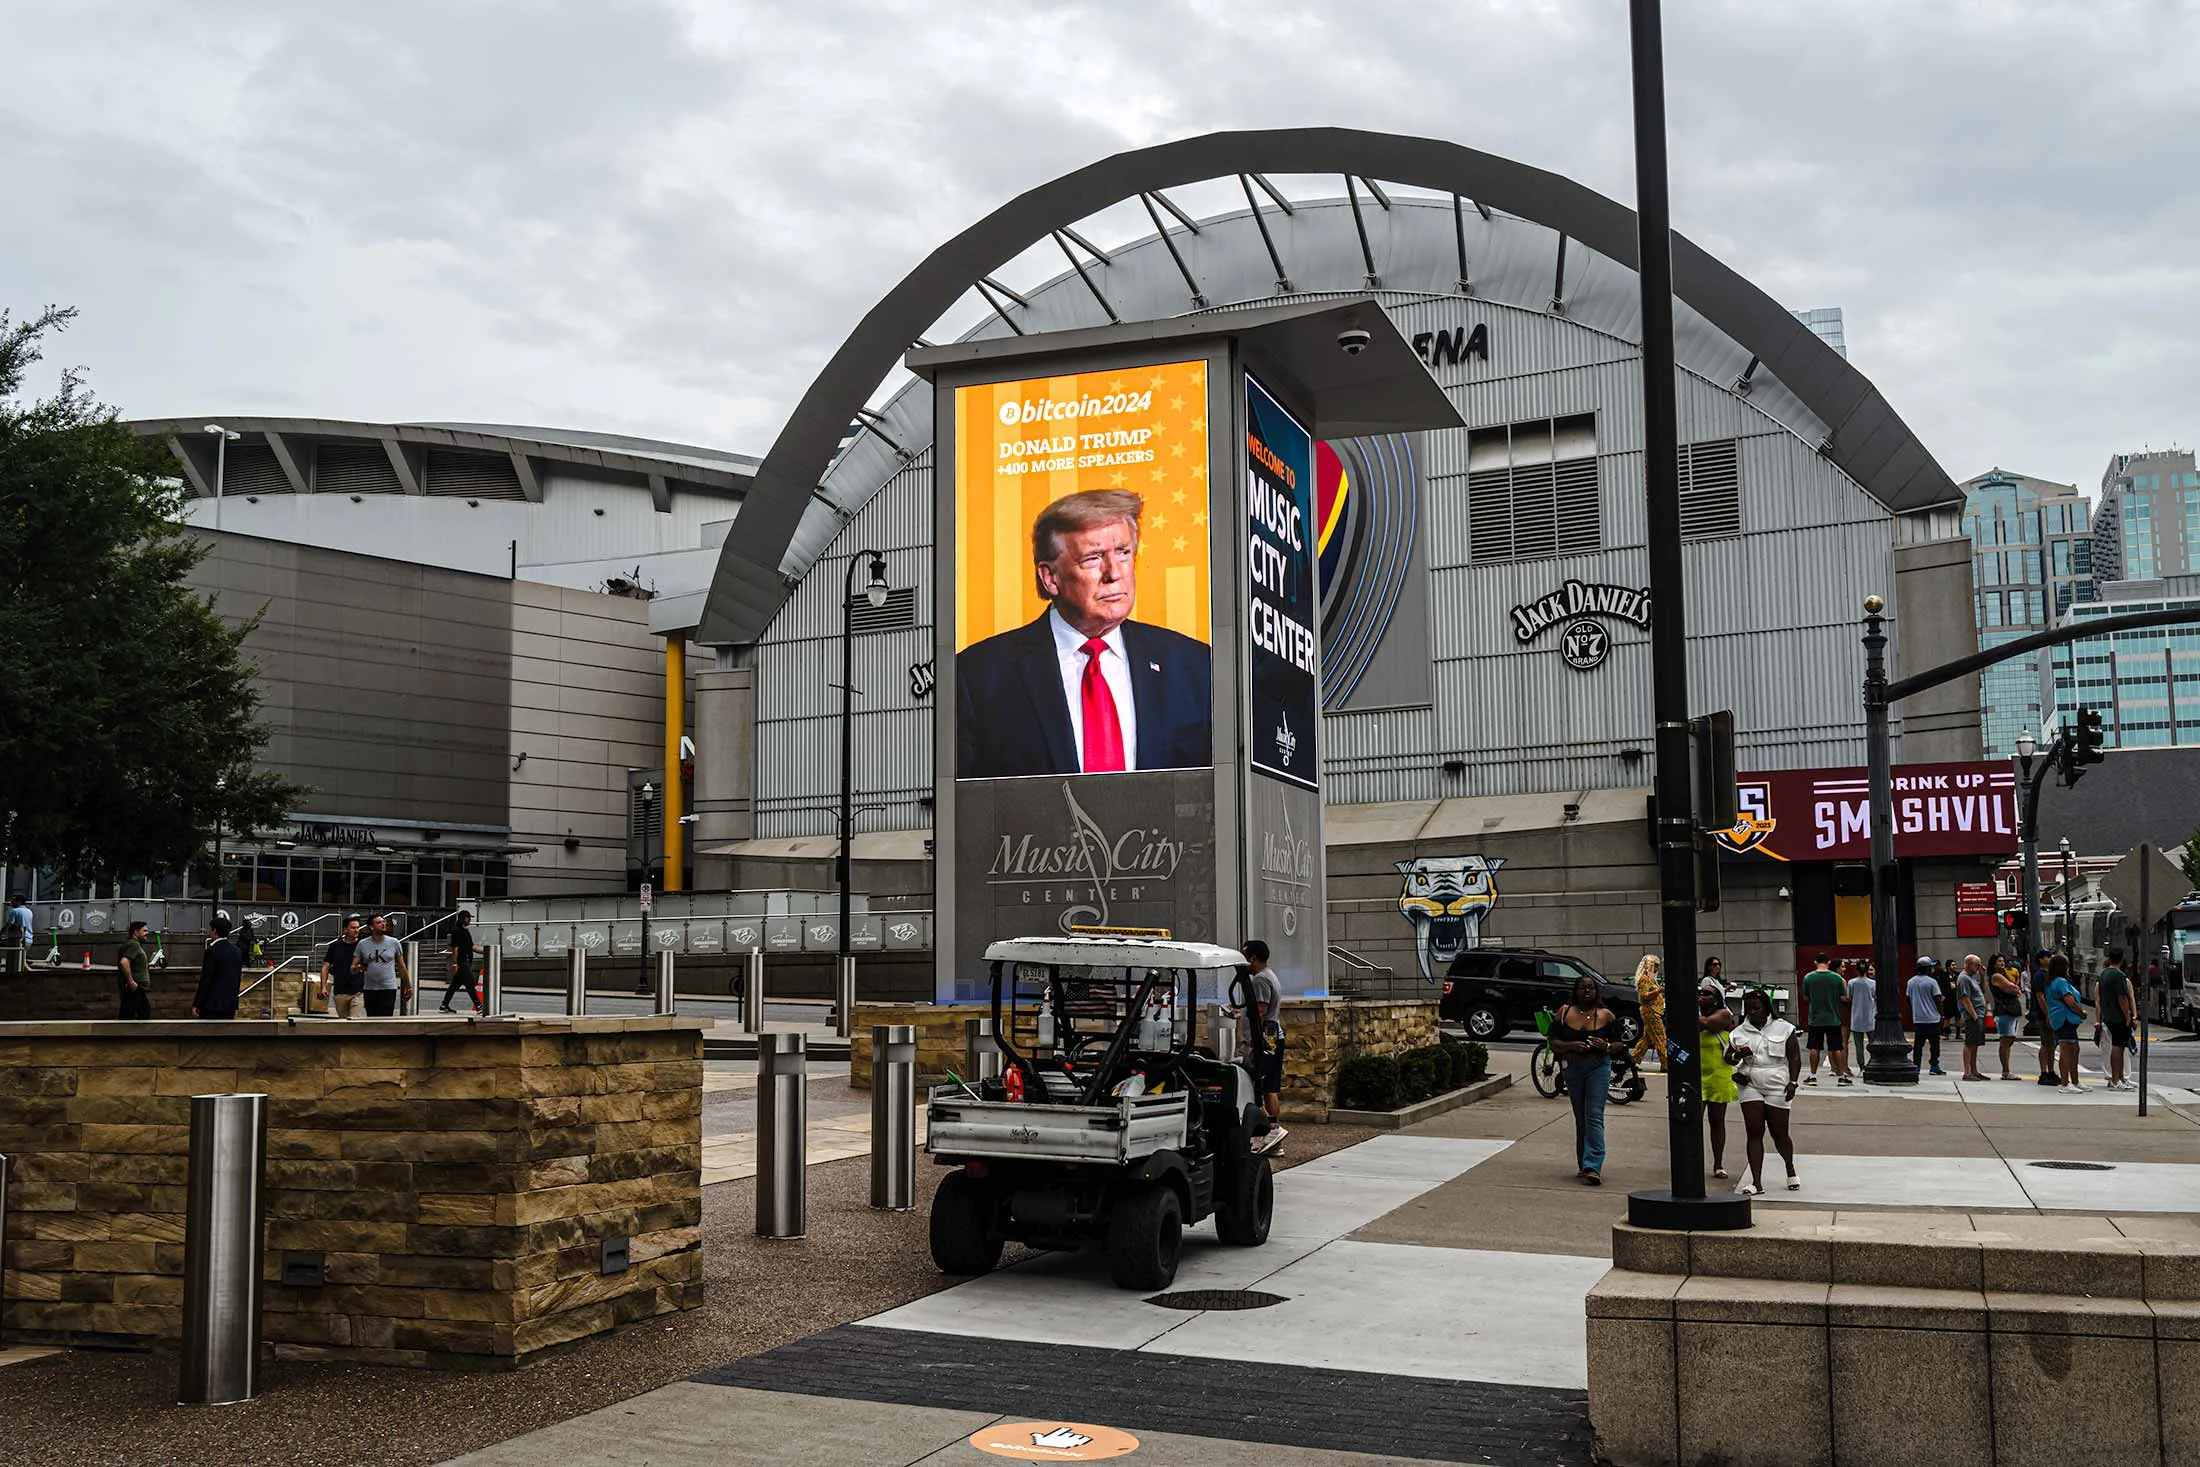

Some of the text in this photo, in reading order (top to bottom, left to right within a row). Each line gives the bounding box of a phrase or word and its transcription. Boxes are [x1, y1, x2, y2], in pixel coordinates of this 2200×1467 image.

[999, 428, 1152, 458] DONALD TRUMP
[997, 449, 1154, 475] +400 MORE SPEAKERS
[1248, 432, 1296, 490] WELCOME TO
[1249, 468, 1302, 552] MUSIC
[1250, 533, 1288, 599] CITY
[1514, 593, 1568, 640] JACK
[1575, 625, 1593, 633] OLD
[1251, 596, 1316, 677] CENTER
[1588, 633, 1603, 656] 7
[1572, 655, 1599, 665] BRAND
[1956, 774, 1985, 788] UP
[988, 827, 1184, 881] Music City
[1023, 889, 1140, 904] CENTER
